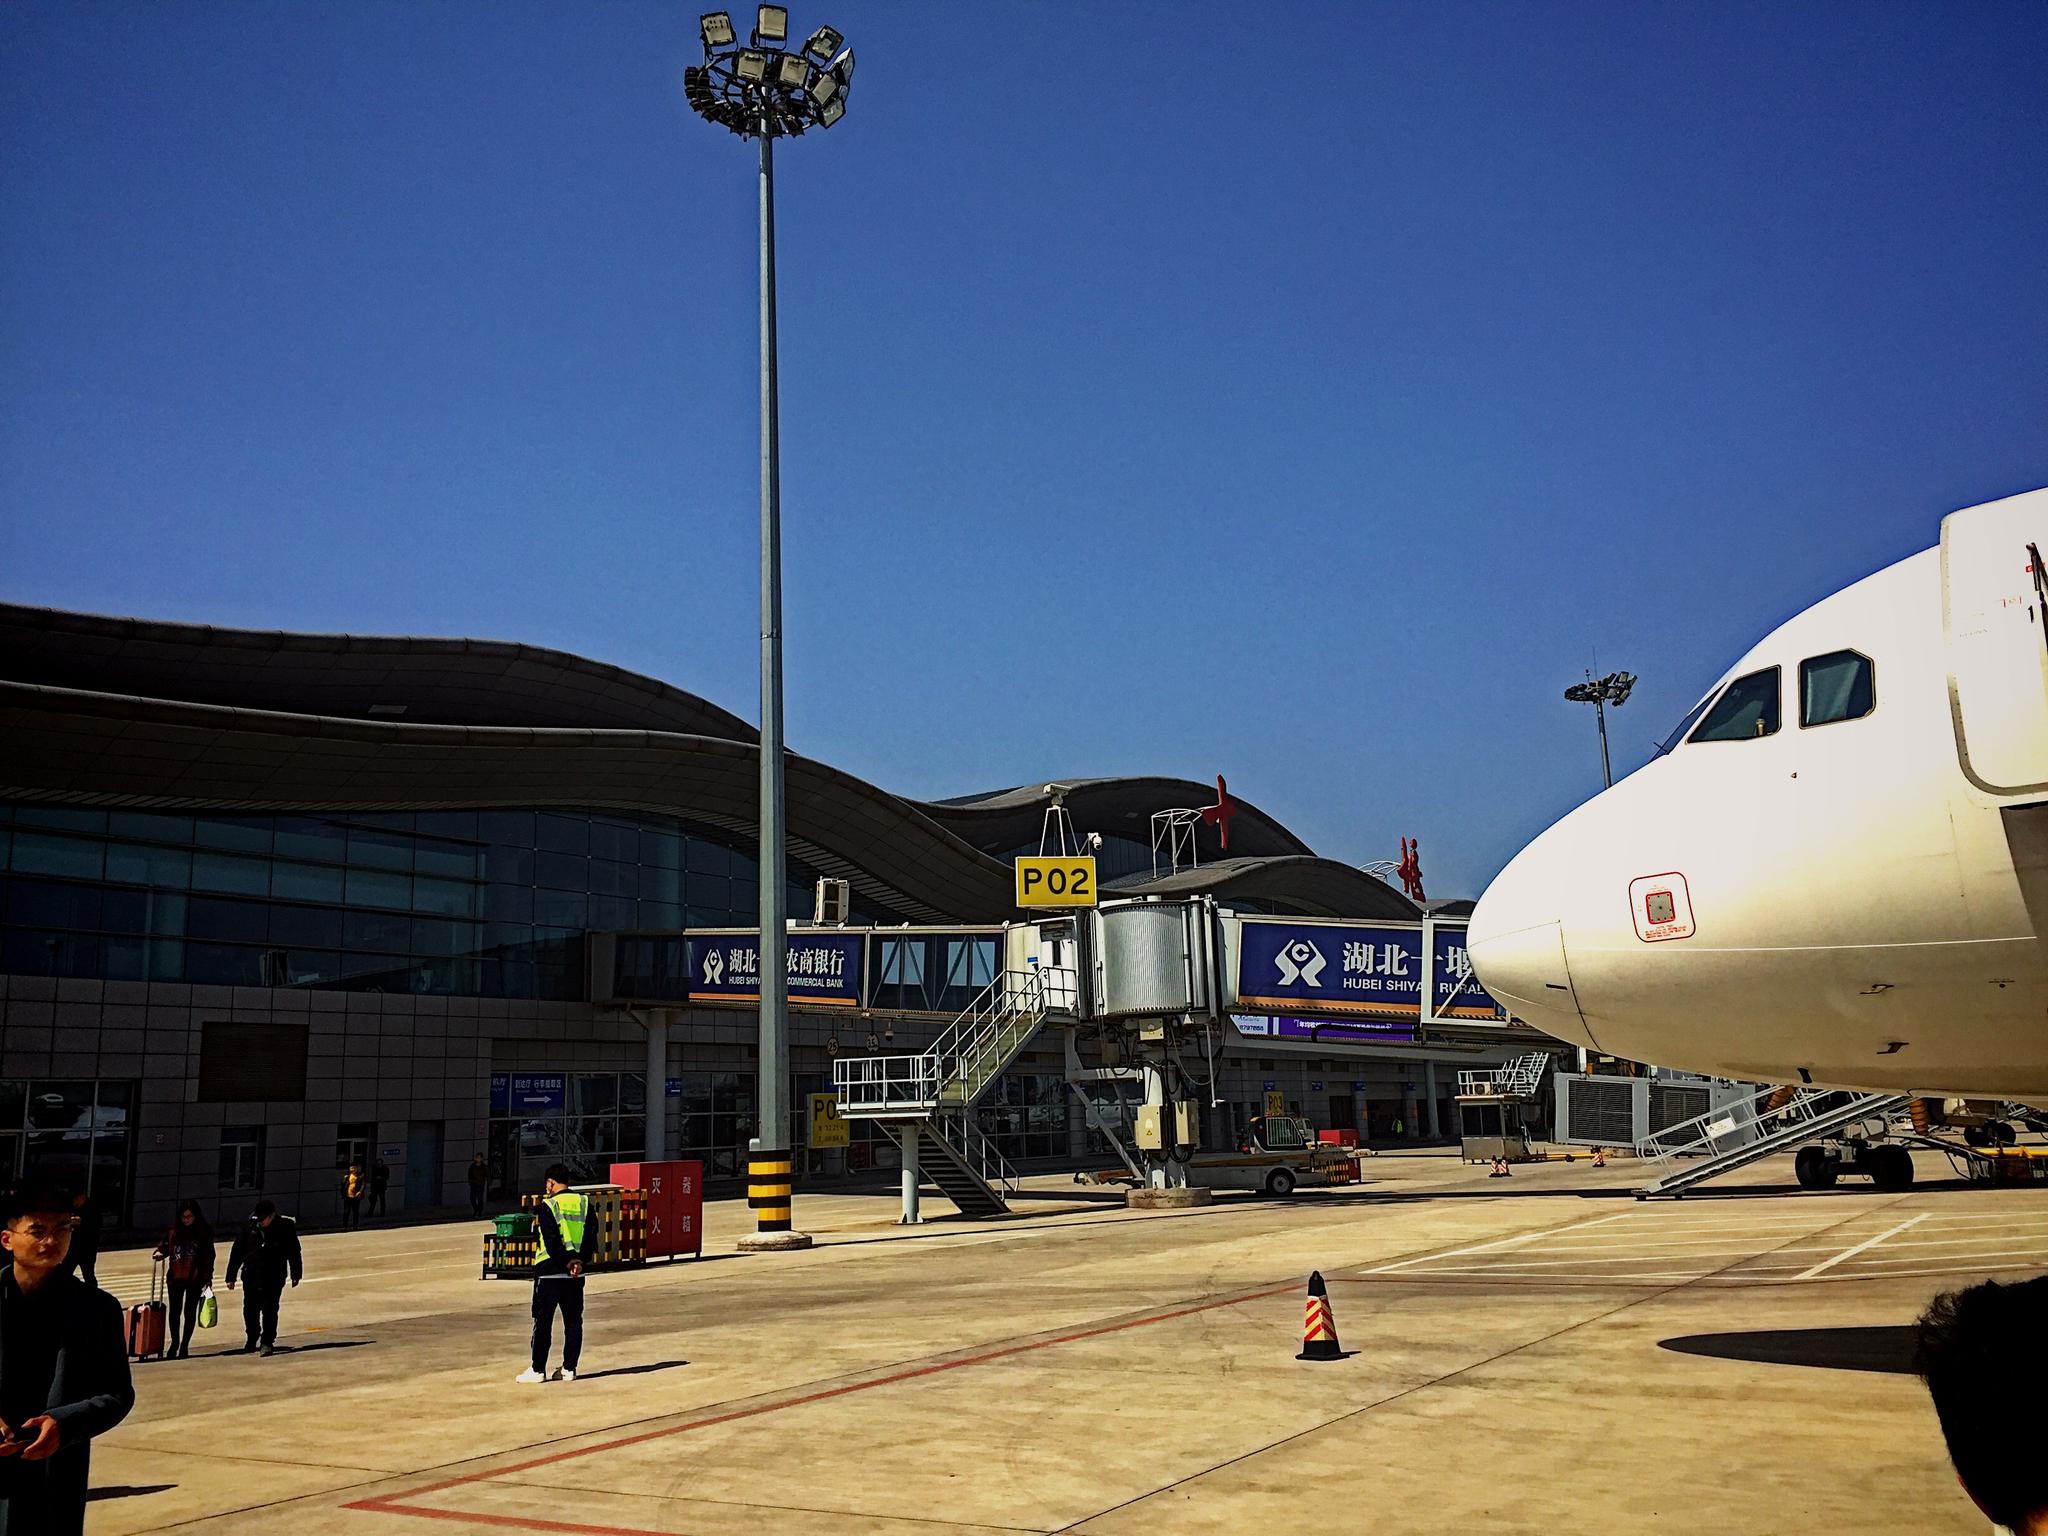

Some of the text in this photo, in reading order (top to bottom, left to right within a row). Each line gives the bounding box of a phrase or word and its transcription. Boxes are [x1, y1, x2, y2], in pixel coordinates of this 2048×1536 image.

[1024, 868, 1089, 895] P02
[729, 948, 845, 976] 湖北农商银行
[728, 976, 844, 989] HUBEI SHIY COMMERCIAL BANK
[1343, 977, 1485, 995] HUBEI SHIYA RURAL
[814, 1099, 839, 1121] P0
